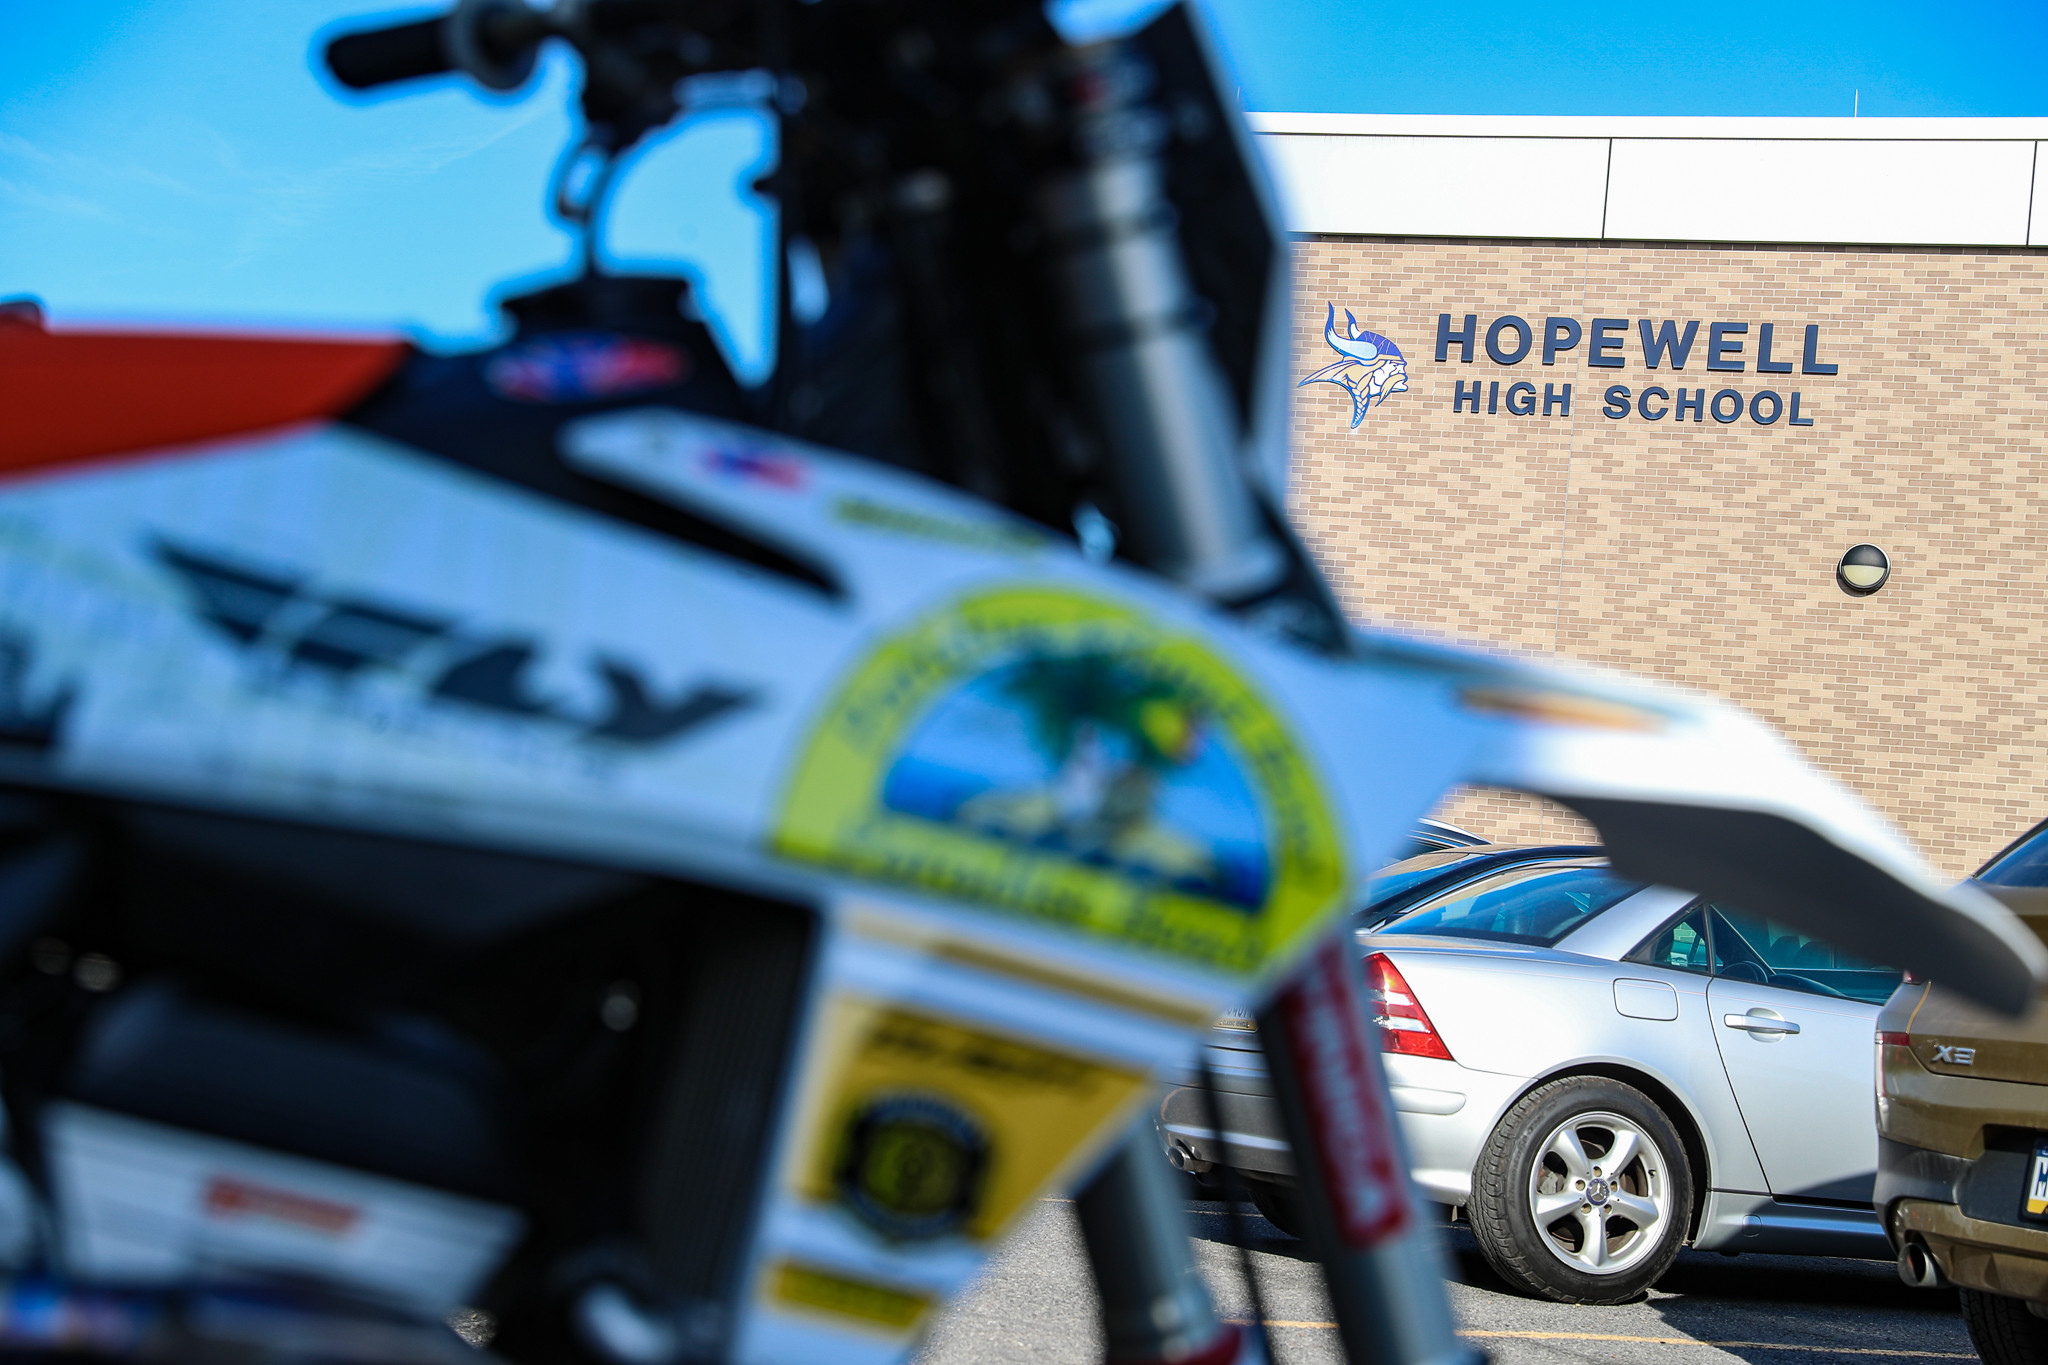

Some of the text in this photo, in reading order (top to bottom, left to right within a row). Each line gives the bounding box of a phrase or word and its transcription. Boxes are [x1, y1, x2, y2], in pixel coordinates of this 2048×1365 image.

[1434, 313, 1839, 376] HOPEWELL
[1453, 379, 1814, 427] HIGH SCHOOL
[1931, 1044, 1977, 1066] X3
